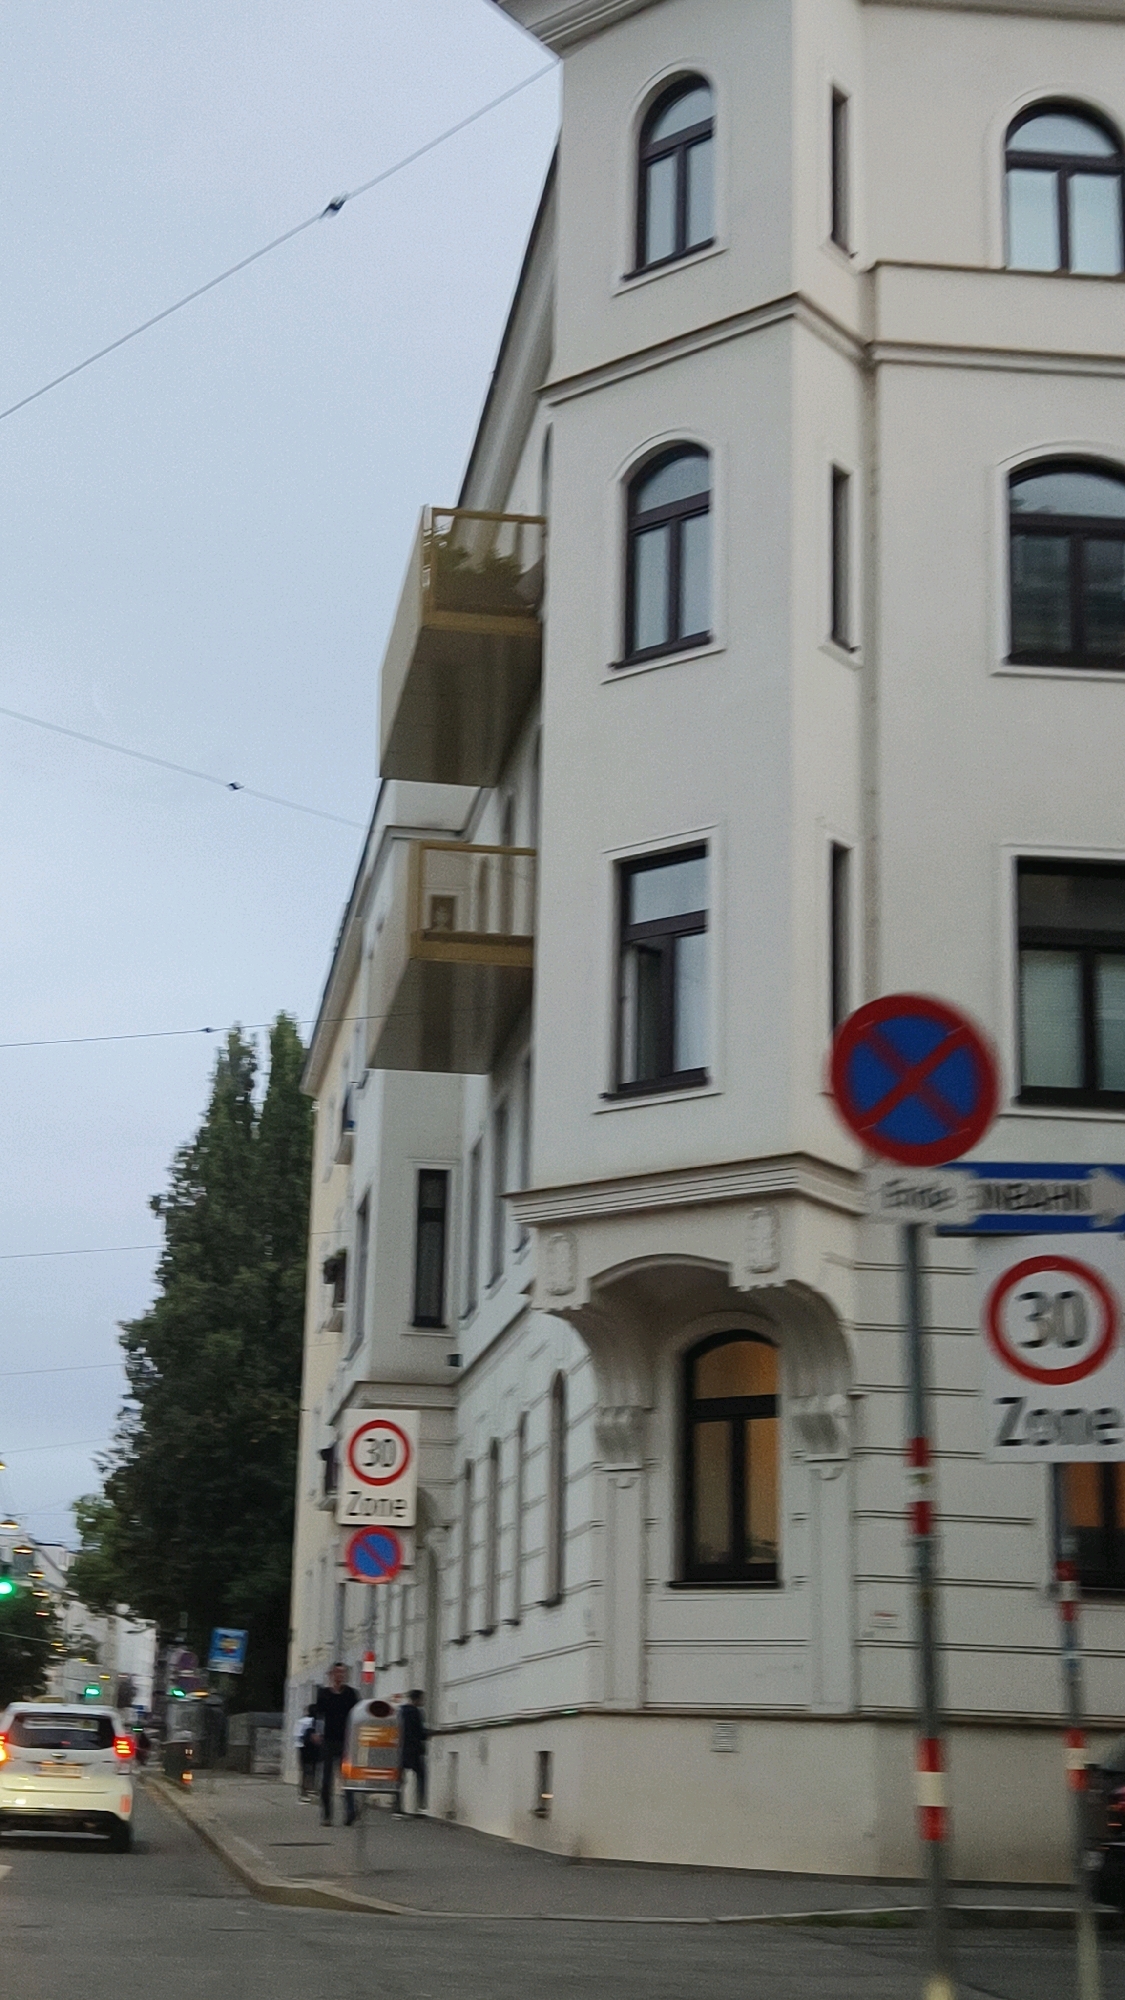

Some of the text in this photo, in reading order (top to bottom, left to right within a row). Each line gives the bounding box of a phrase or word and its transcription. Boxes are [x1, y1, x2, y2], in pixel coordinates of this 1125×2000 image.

[1015, 1290, 1089, 1349] 30
[994, 1396, 1124, 1446] Zone
[362, 1438, 397, 1467] 30
[346, 1491, 407, 1517] Zone
